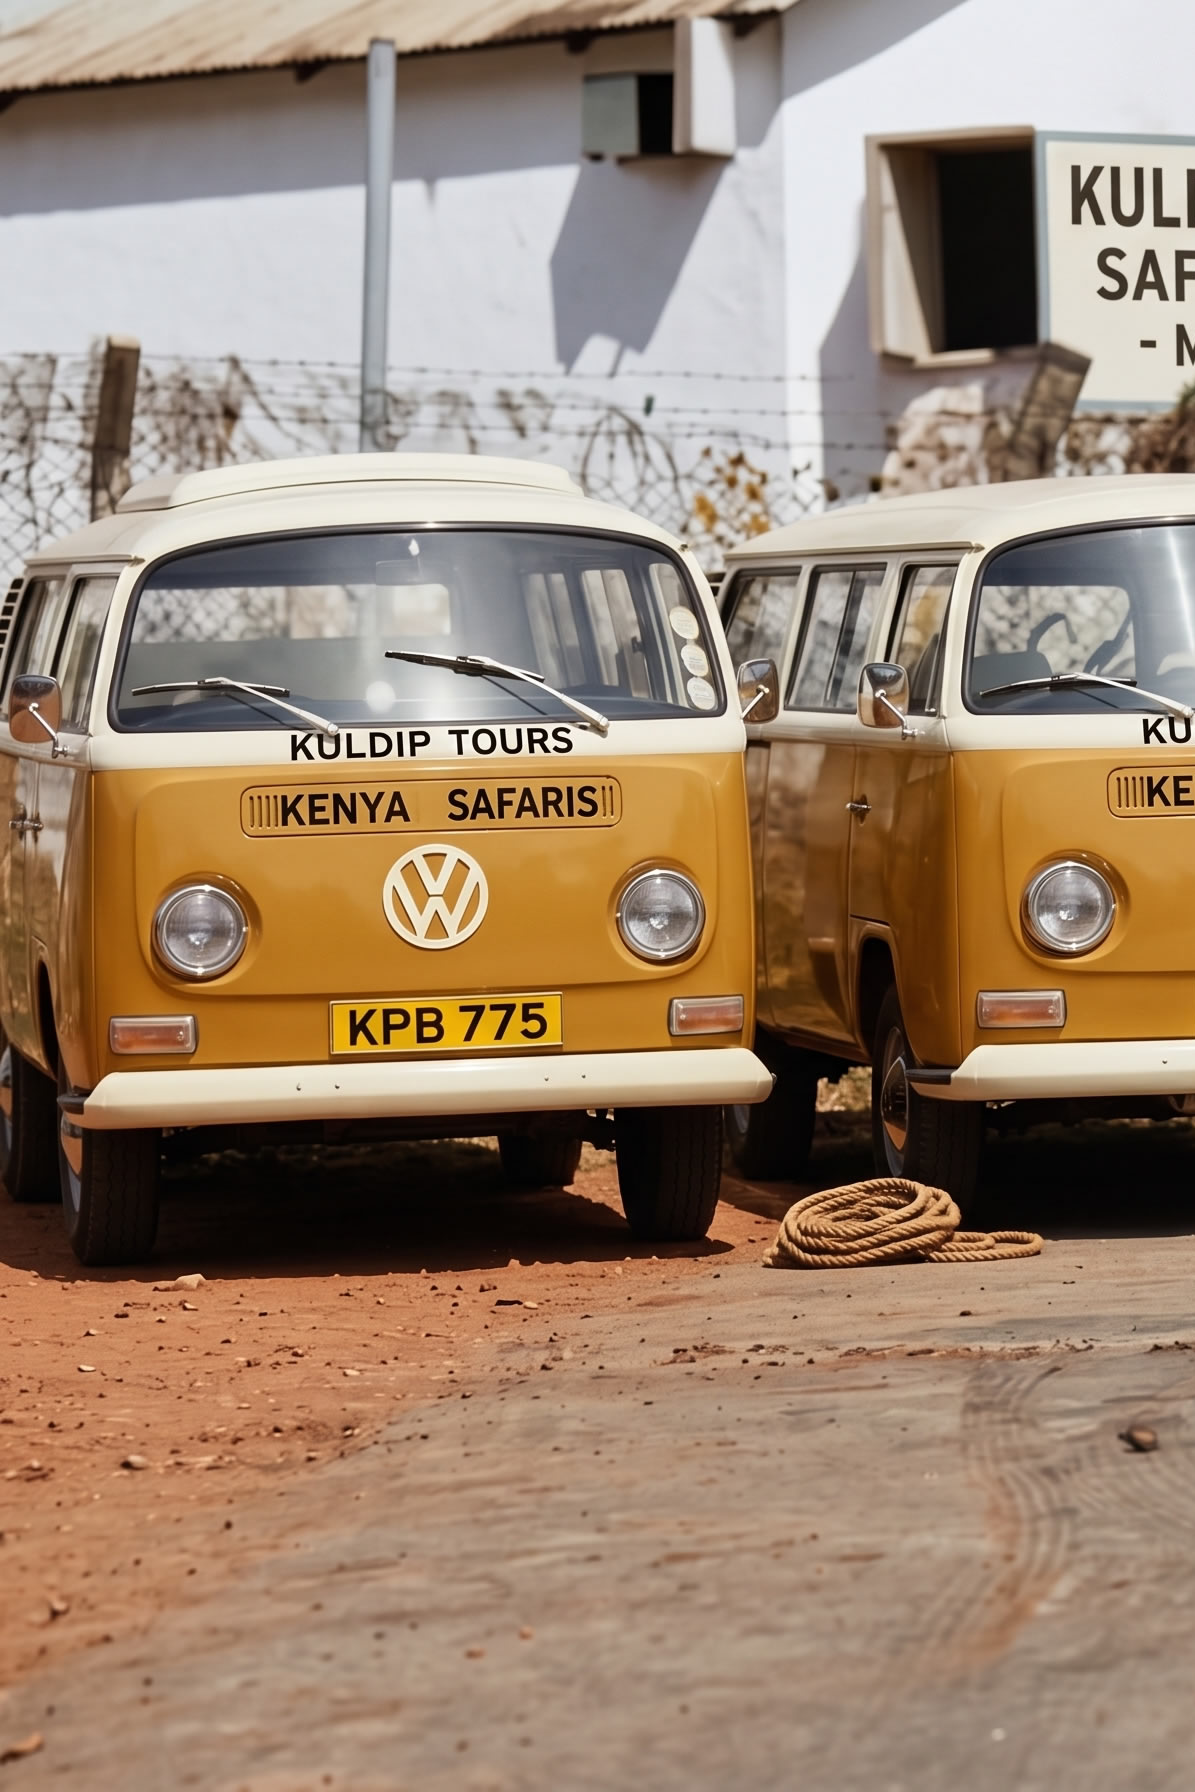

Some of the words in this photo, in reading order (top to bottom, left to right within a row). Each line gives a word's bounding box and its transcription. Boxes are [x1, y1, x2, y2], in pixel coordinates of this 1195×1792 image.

[290, 730, 431, 761] KULDIP
[447, 726, 573, 756] TOURS
[280, 791, 411, 827] KENYA
[447, 785, 599, 821] SAFARIS
[349, 1007, 445, 1046] KPB
[458, 1002, 548, 1042] 775
